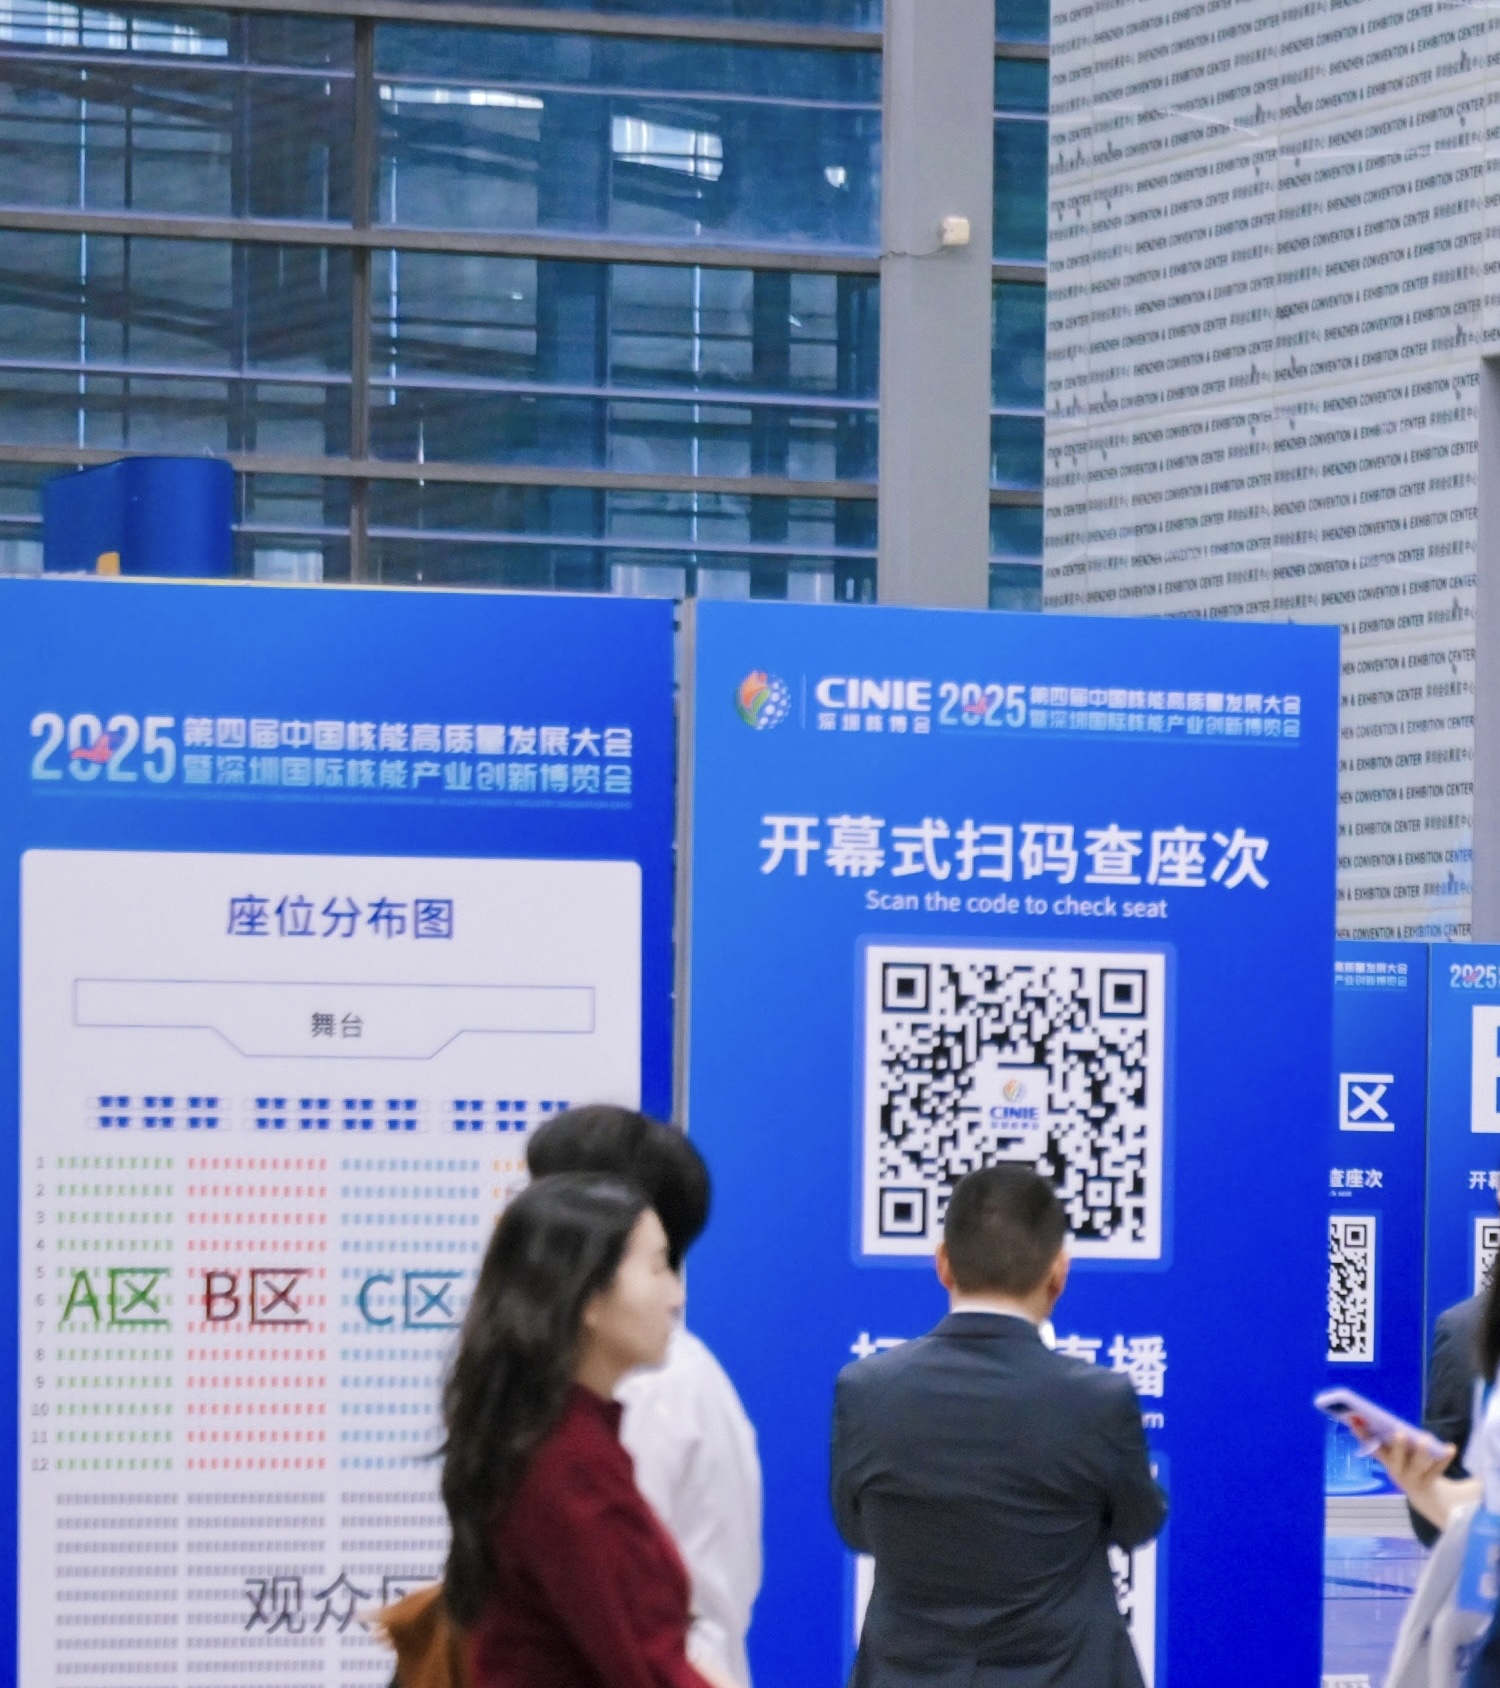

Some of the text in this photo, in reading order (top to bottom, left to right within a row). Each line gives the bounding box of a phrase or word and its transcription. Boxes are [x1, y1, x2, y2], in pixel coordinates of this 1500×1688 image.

[816, 678, 932, 711] CINIE
[937, 682, 1026, 727] 2025
[30, 712, 176, 783] 2025
[183, 716, 633, 758] 第四届中国核能高质量发展大会
[183, 754, 633, 795] 暨深圳国际核能产业创新博览会
[759, 814, 1270, 891] 开幕式扫码查座次
[226, 894, 457, 941] 座位分布图
[866, 888, 1168, 920] Scan the code to check seat
[1449, 963, 1498, 990] 2025
[311, 1012, 364, 1039] 舞台
[61, 1268, 171, 1327] A区
[205, 1268, 309, 1327] B区
[357, 1271, 466, 1330] C区
